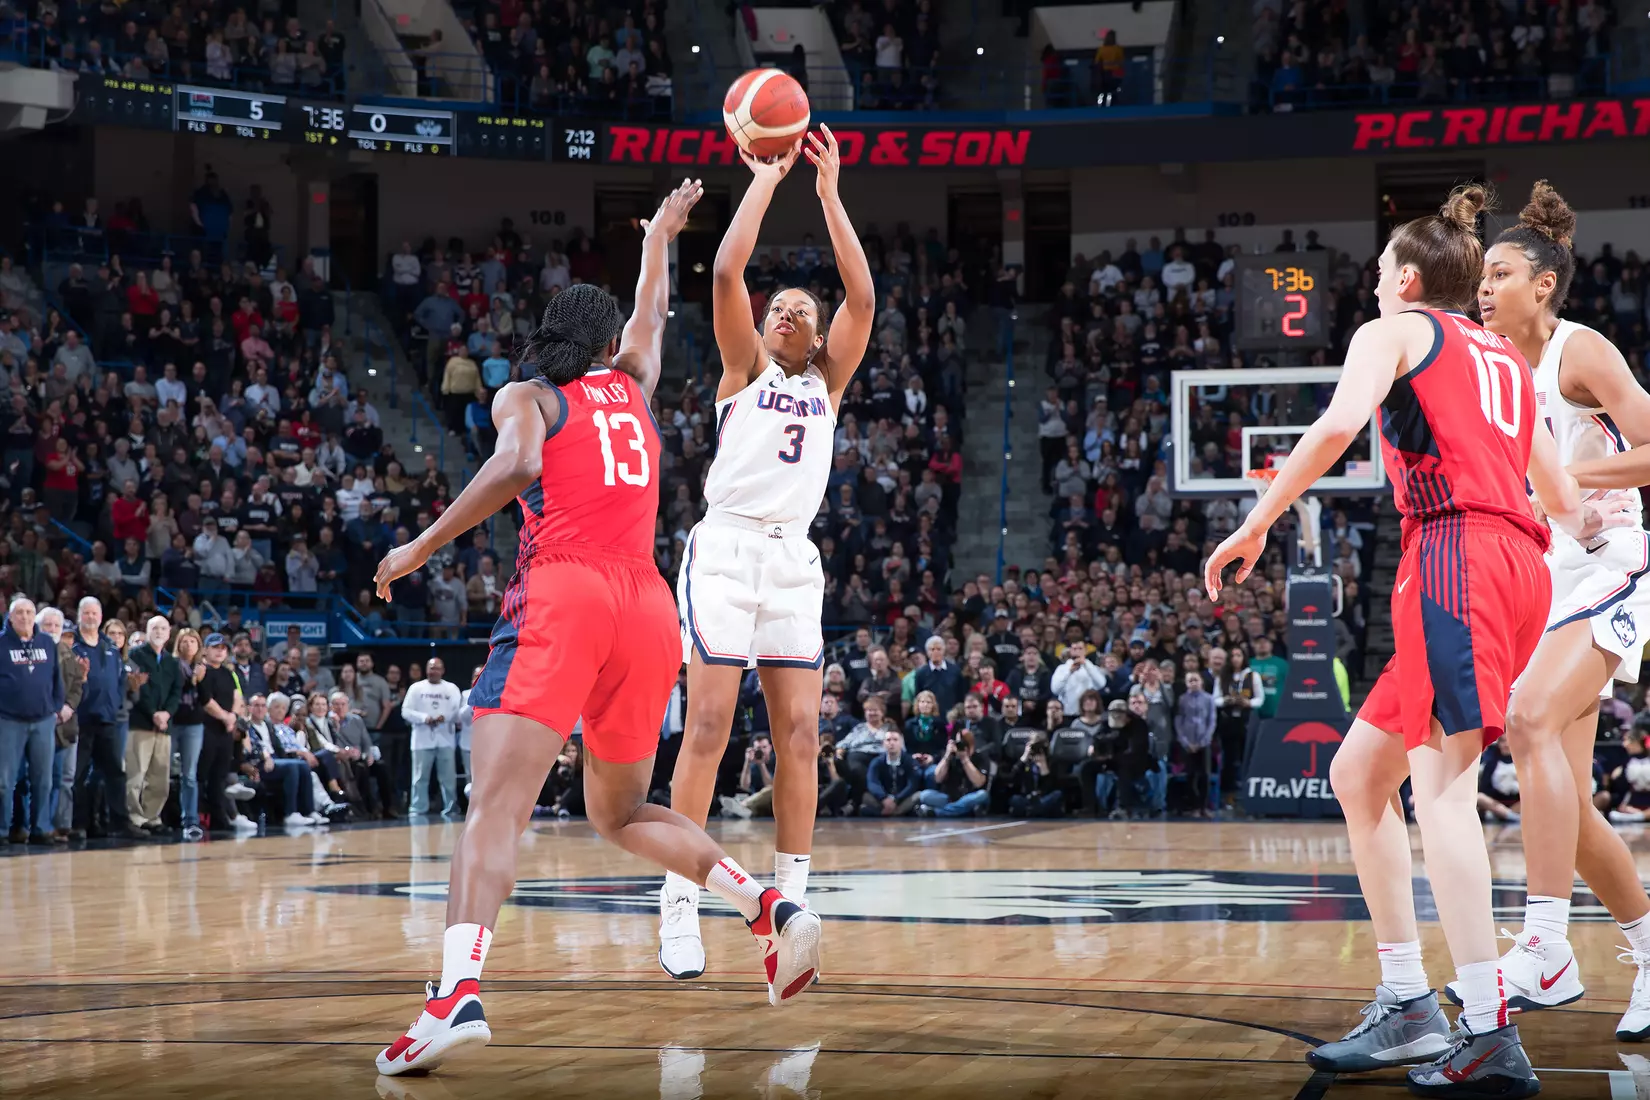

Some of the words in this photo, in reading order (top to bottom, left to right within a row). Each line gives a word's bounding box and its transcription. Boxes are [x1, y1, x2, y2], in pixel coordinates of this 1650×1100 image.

[250, 100, 263, 120] 5
[302, 106, 344, 130] 7:36
[188, 121, 206, 132] FLS
[236, 126, 256, 138] TOL
[370, 114, 386, 132] 0
[1353, 110, 1434, 150] P.C.
[357, 140, 377, 150] TOL
[404, 143, 423, 153] FLS
[431, 144, 439, 154] 0
[564, 129, 595, 144] 7:12
[609, 126, 865, 165] RICHD
[869, 131, 909, 166] &
[918, 130, 1031, 166] SON
[568, 145, 590, 159] PM
[1264, 267, 1314, 292] 7:36
[1282, 294, 1308, 336] 2
[1468, 342, 1521, 438] 10
[757, 390, 826, 418] UCONN
[592, 410, 650, 487] 13
[778, 424, 806, 464] 3
[1248, 777, 1335, 799] TRAVEL
